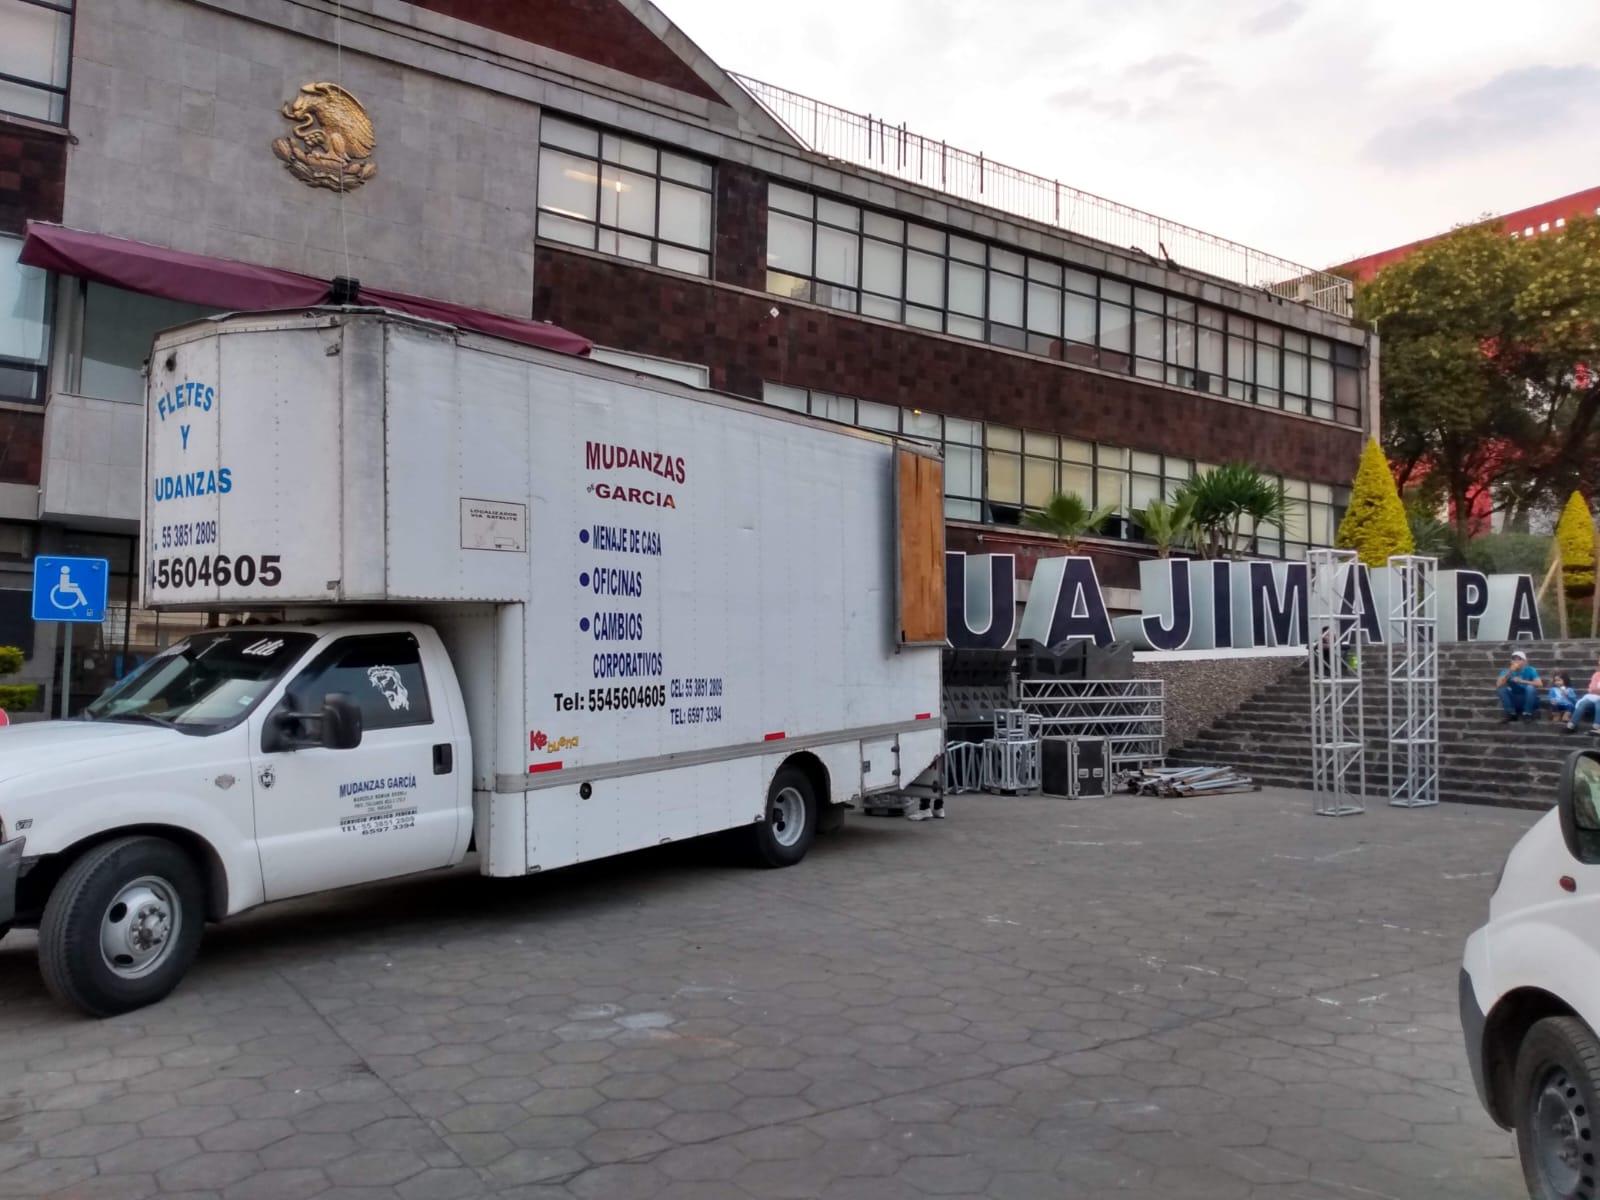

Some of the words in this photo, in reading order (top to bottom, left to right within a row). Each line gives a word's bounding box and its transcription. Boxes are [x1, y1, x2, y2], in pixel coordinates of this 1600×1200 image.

[158, 382, 214, 421] FLETES
[180, 425, 191, 450] Y
[586, 440, 686, 484] MUDANZAS
[595, 483, 676, 509] GARCIA
[163, 525, 171, 548] 55
[174, 523, 193, 547] 3851
[196, 520, 217, 545] 2809
[593, 524, 627, 553] MENAJE
[629, 529, 640, 554] DE
[642, 531, 662, 556] CASA
[593, 567, 642, 598] OFICINAS
[593, 612, 643, 641] CAMBIOS
[593, 652, 663, 678] CORPORATIVOS
[554, 693, 585, 712] Tel:
[588, 685, 666, 712] 5545604605
[686, 678, 693, 697] 55
[694, 678, 708, 696] 3851
[670, 708, 686, 725] TEL:
[687, 707, 704, 723] 6597
[706, 705, 721, 722] 3394
[339, 779, 385, 798] MUDANZAS
